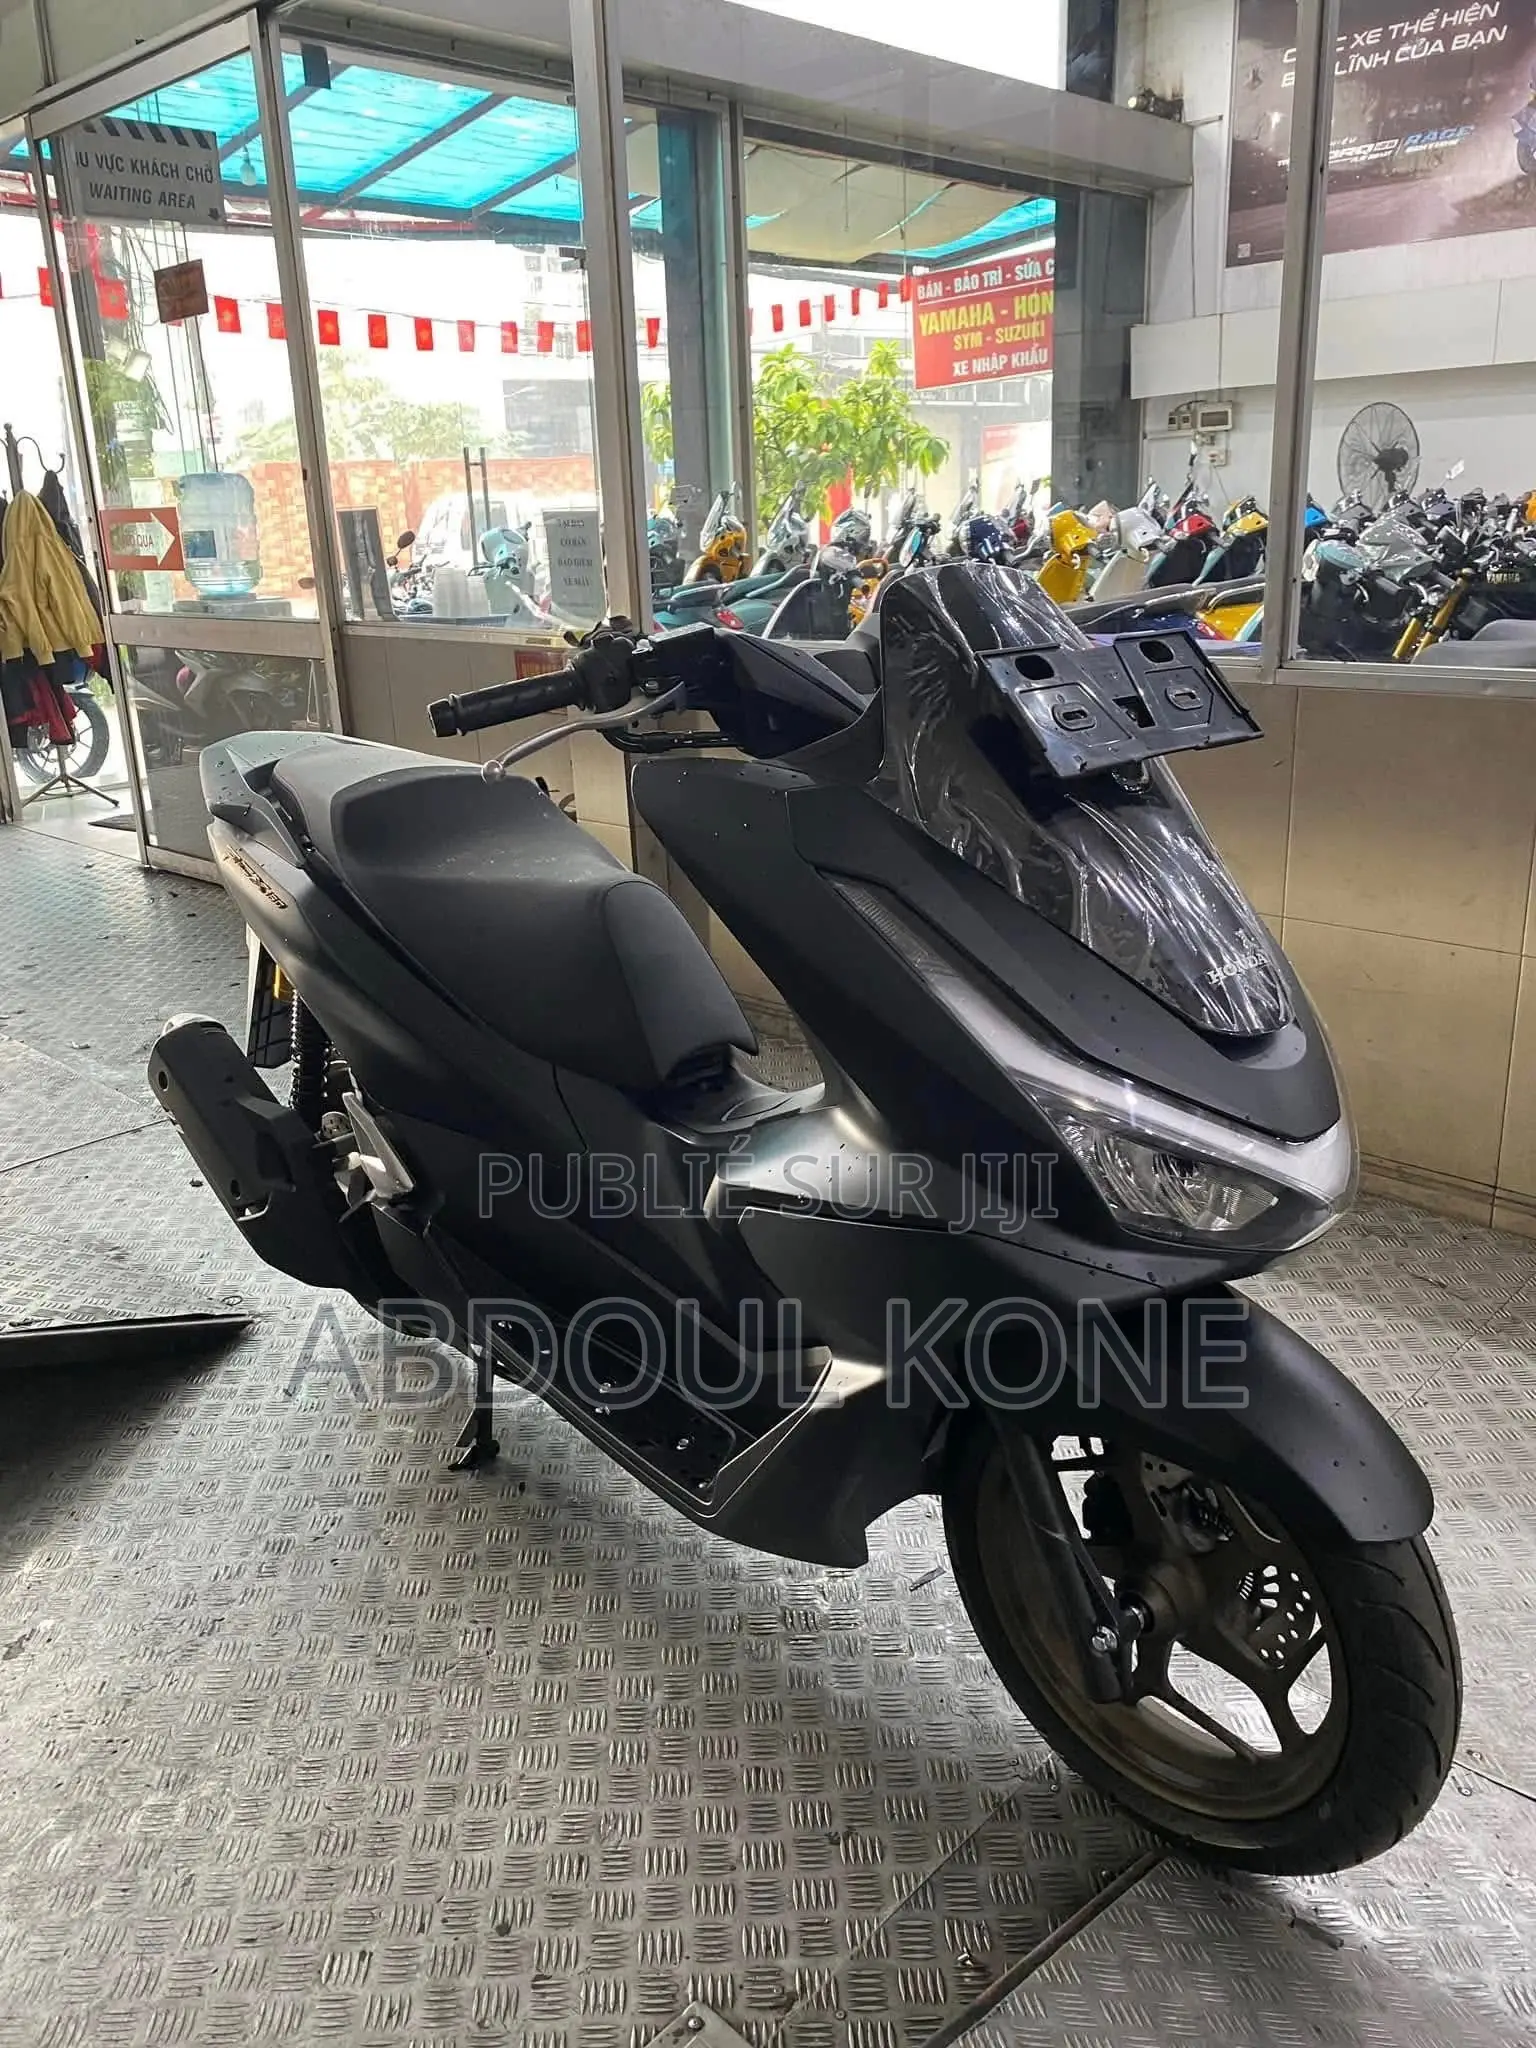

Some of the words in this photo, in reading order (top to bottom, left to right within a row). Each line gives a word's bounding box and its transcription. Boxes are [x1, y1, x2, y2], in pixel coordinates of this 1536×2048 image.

[1350, 27, 1384, 49] XE
[1388, 8, 1440, 40] THỂ
[1441, 1, 1500, 29] HIỆN
[1395, 37, 1445, 63] CỦA
[1451, 24, 1508, 51] BẠN
[94, 151, 125, 174] VỰC
[130, 156, 180, 180] KHÁCH
[89, 182, 153, 205] WAITING
[158, 191, 196, 210] AREA
[918, 301, 996, 337] YAMAHA
[953, 331, 983, 351] SYM
[995, 319, 1046, 344] SUZUKI
[952, 360, 969, 377] XE
[972, 352, 1008, 375] NHẬP
[1205, 951, 1269, 986] HONDA
